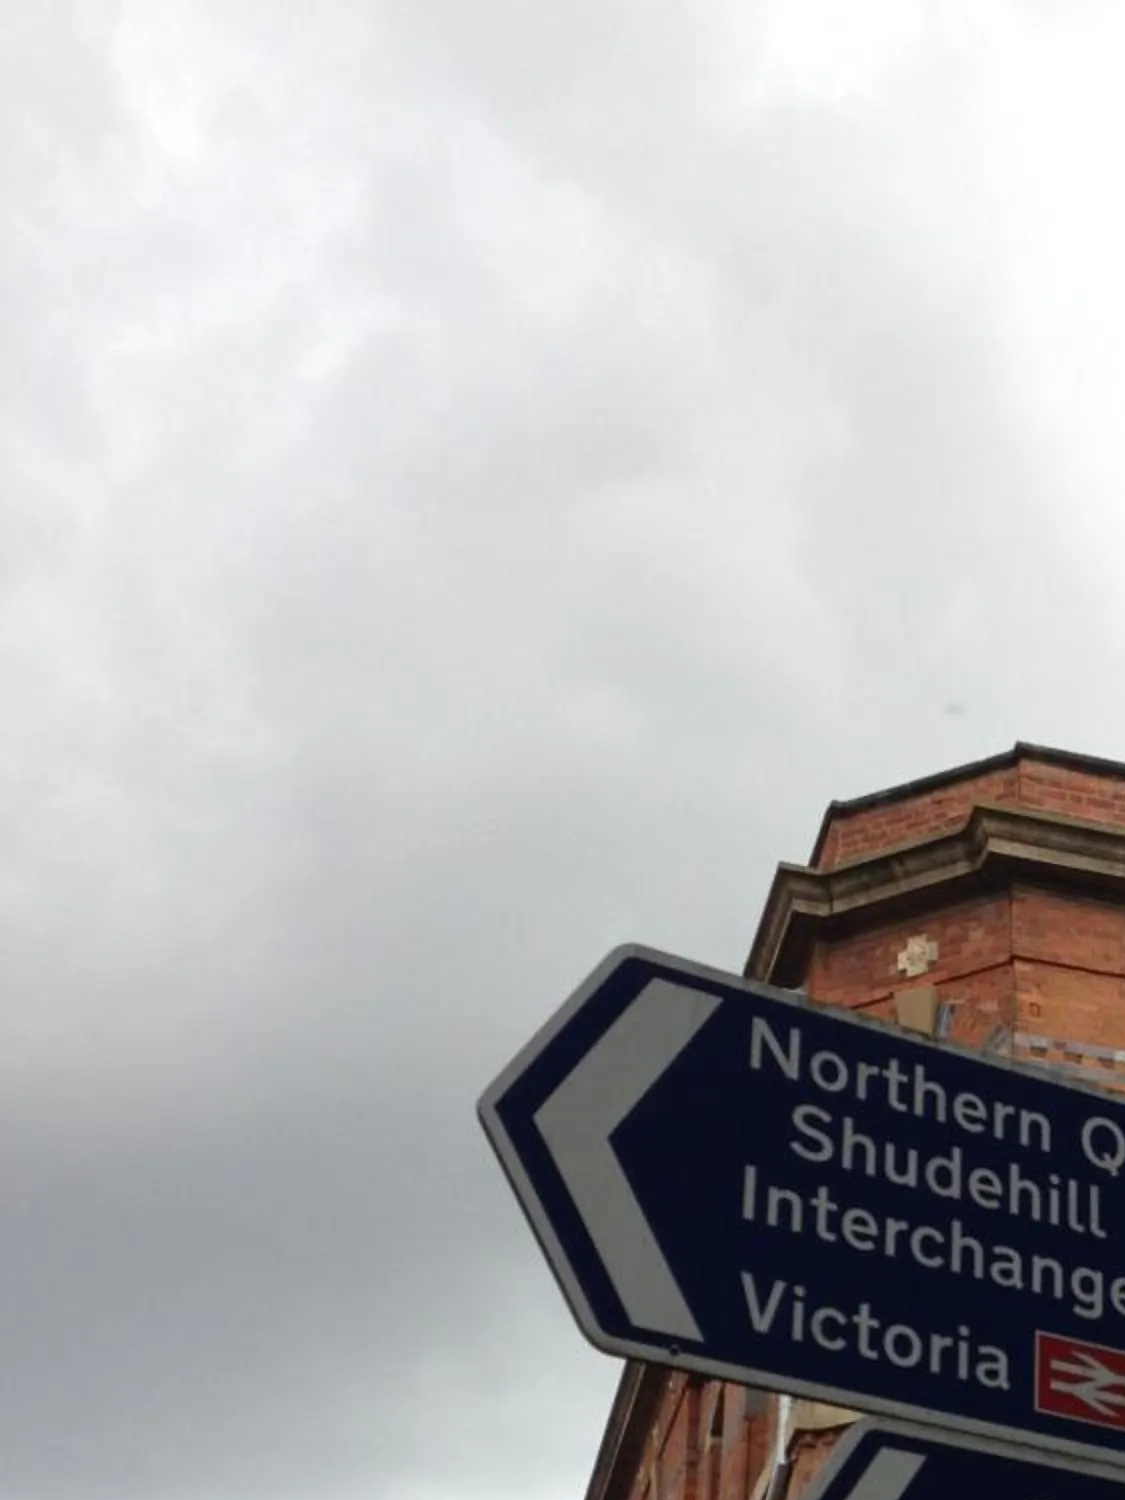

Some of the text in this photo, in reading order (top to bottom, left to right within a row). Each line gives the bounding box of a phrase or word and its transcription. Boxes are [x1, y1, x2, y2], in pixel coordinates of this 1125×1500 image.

[750, 1016, 1051, 1153] Northern
[790, 1104, 1107, 1239] Shudehill
[741, 1271, 1010, 1391] Victoria
